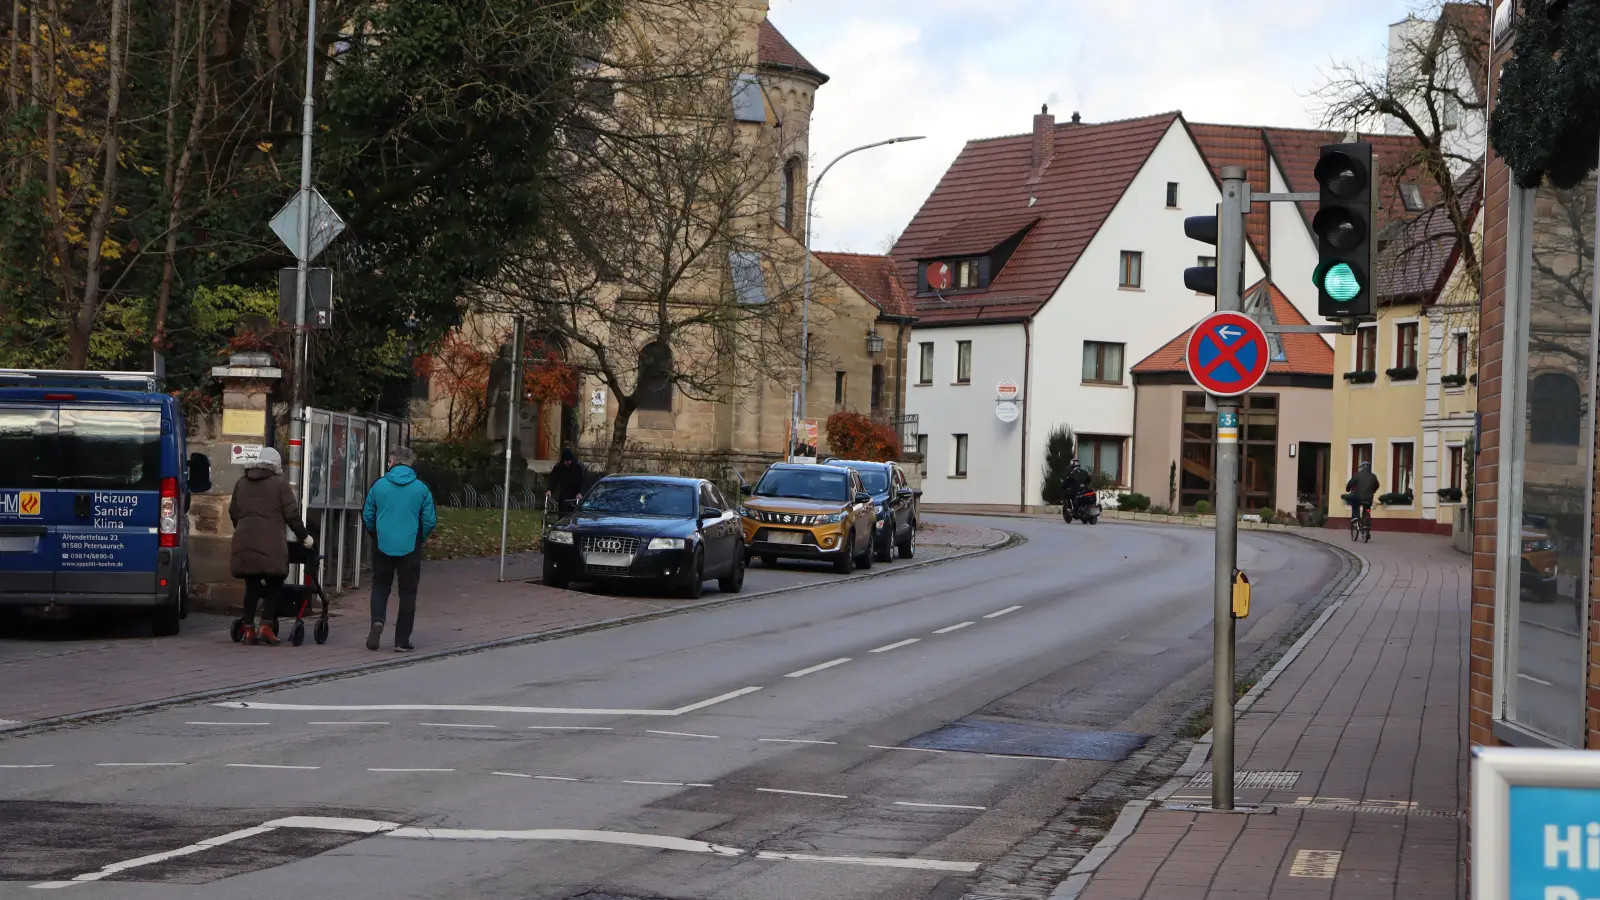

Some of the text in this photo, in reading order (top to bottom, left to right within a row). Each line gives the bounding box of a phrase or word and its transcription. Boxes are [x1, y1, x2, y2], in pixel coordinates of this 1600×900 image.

[1225, 414, 1232, 426] 3
[94, 492, 138, 506] Heizung
[94, 506, 134, 517] Sanitär
[94, 518, 124, 529] Klima
[62, 533, 109, 541] Altendettelsau
[83, 542, 124, 550] Petersaurach
[1544, 822, 1600, 869] Hi
